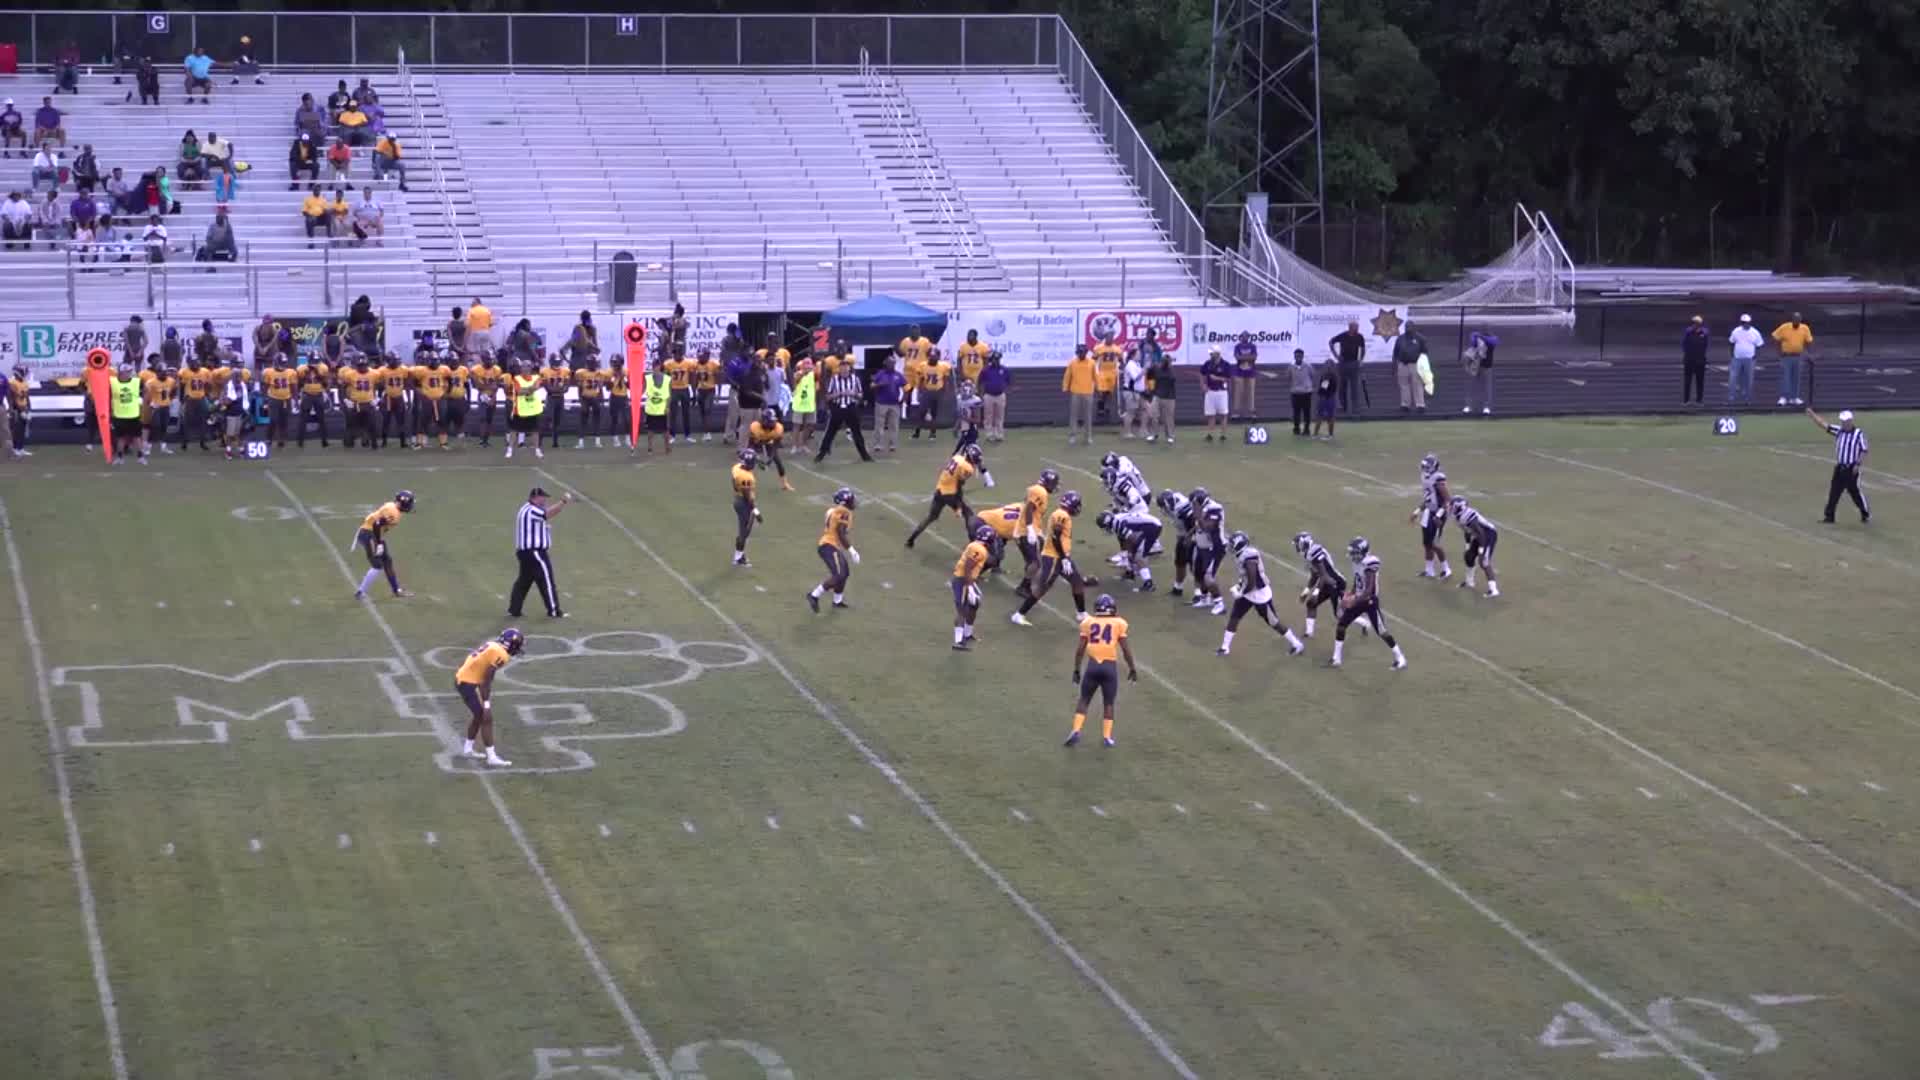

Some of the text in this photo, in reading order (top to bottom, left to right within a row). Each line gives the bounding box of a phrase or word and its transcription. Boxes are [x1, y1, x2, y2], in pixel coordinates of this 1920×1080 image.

[151, 15, 166, 31] G
[621, 17, 634, 32] H
[695, 316, 728, 329] INC
[1017, 314, 1042, 325] Paula
[1124, 313, 1175, 327] Wayne
[58, 331, 126, 344] EXPRES
[691, 331, 717, 340] AND
[813, 329, 830, 352] 2
[1208, 330, 1293, 344] BancpSouth
[1719, 418, 1737, 433] 20
[1249, 427, 1267, 443] 30
[248, 441, 267, 457] 50
[1089, 623, 1112, 645] 24
[1538, 997, 1782, 1058] 40
